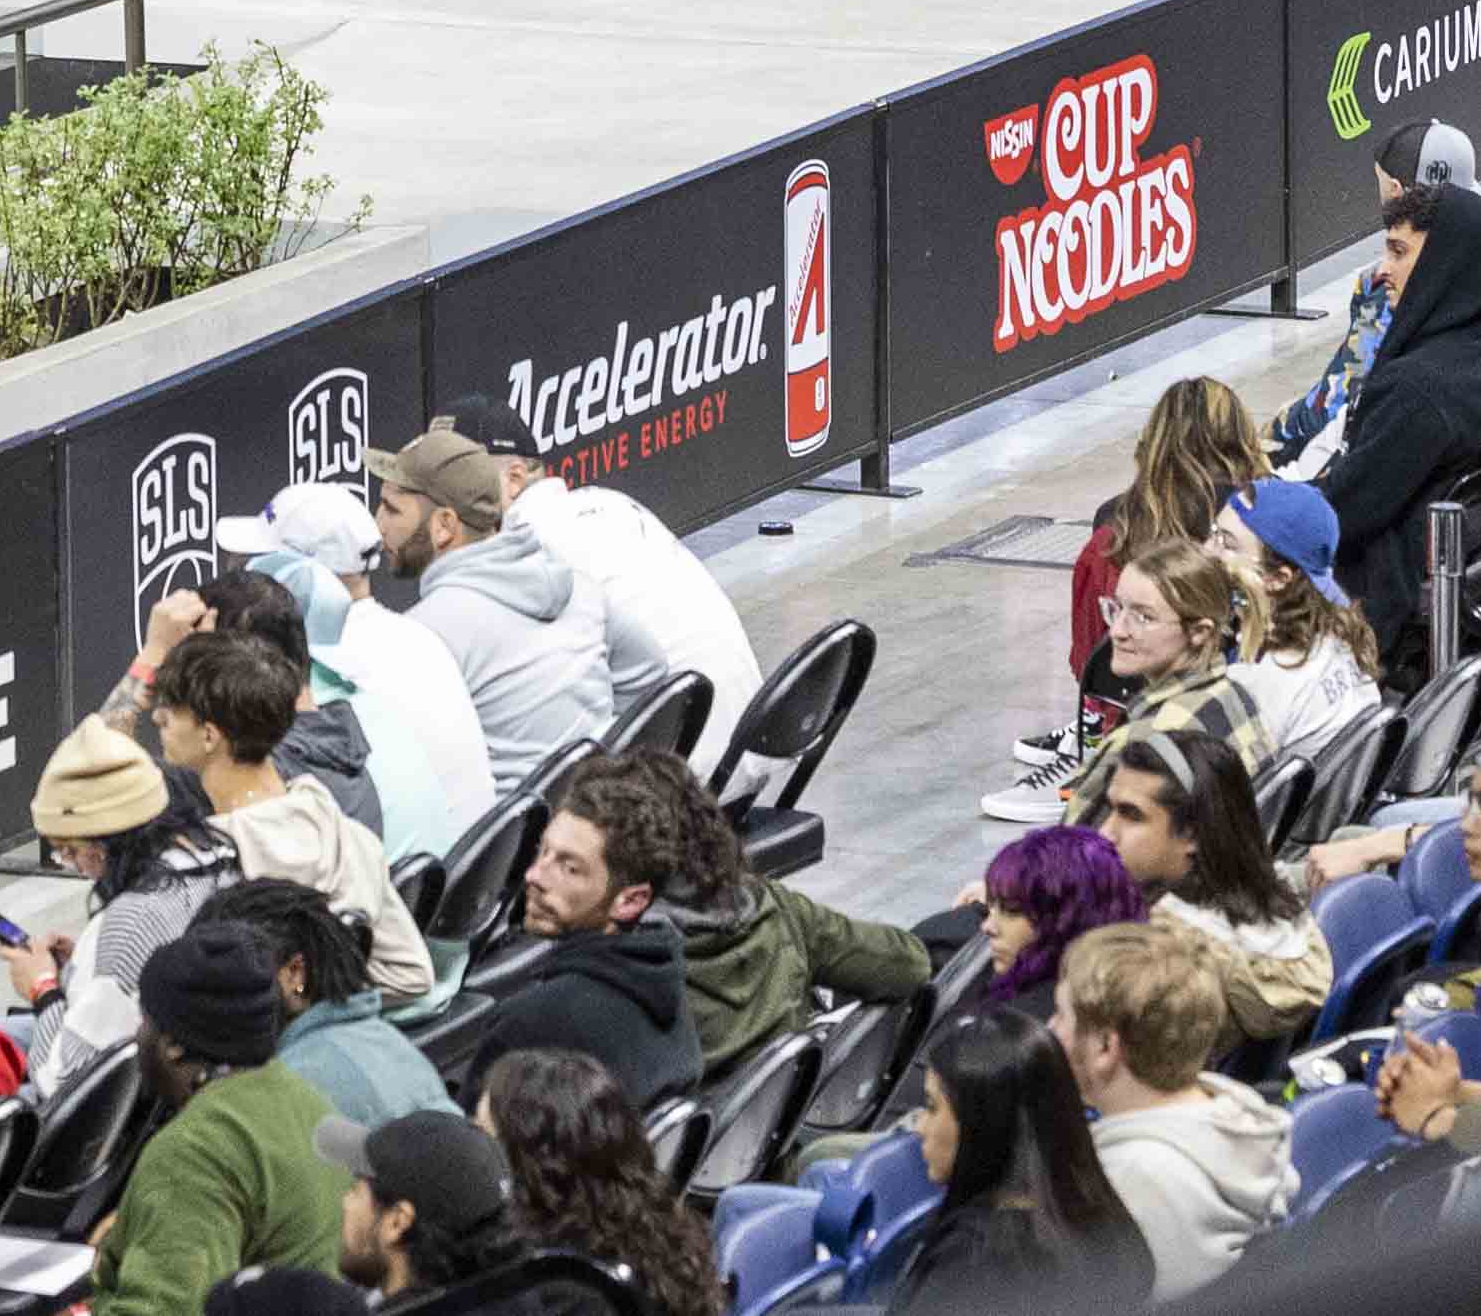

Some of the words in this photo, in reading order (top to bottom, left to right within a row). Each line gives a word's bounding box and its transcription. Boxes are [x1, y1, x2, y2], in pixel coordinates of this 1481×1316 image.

[989, 118, 1034, 160] NISSIN
[1045, 67, 1153, 201] CUP
[998, 158, 1191, 340] NOODLES
[296, 386, 362, 486] SLS
[640, 390, 729, 461] ENERGY
[140, 451, 210, 566] SLS
